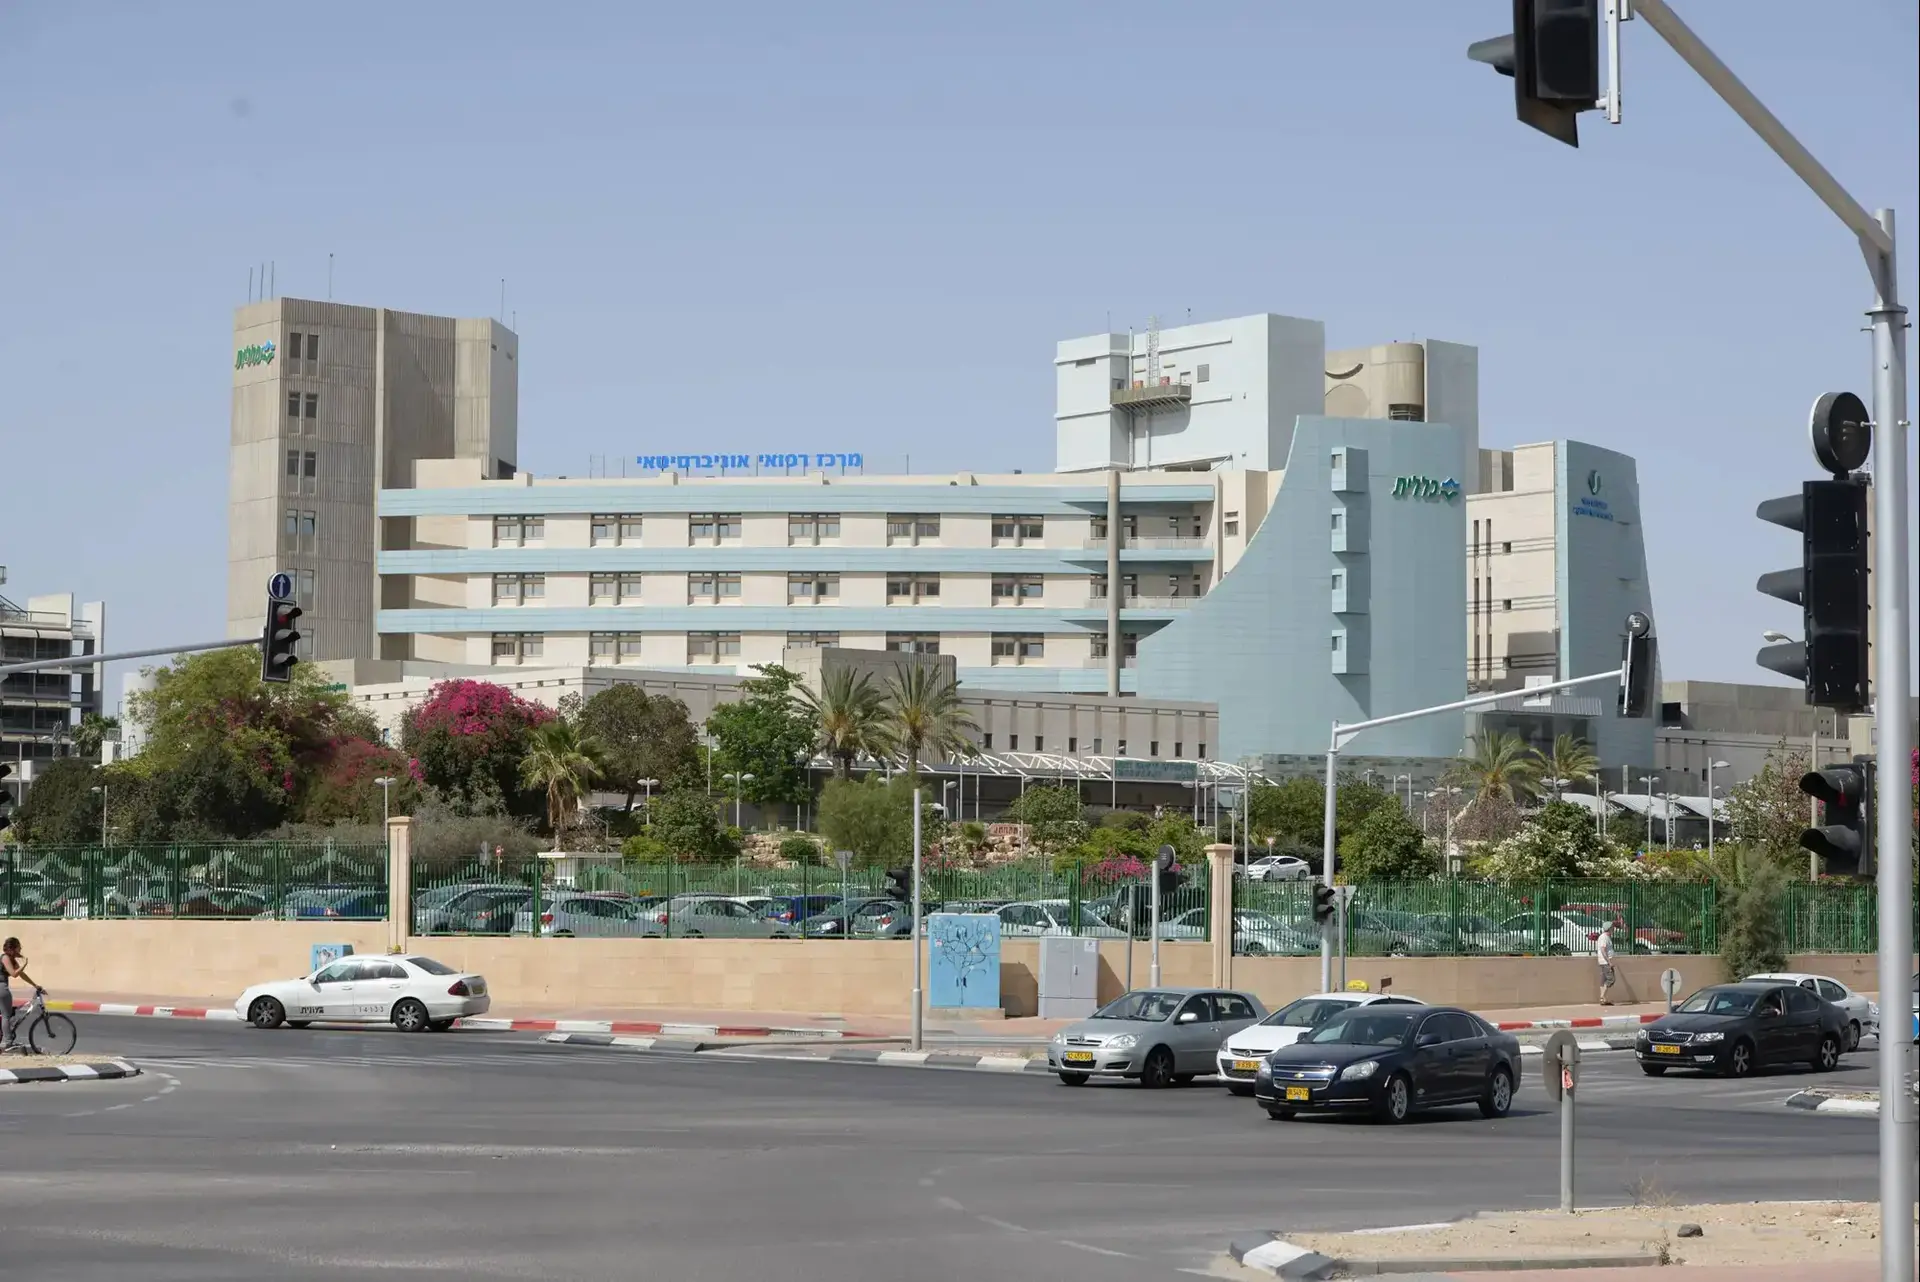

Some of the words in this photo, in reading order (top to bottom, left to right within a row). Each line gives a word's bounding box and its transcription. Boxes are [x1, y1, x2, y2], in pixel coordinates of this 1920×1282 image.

[636, 454, 749, 469] אוניברסיטאי
[758, 453, 809, 468] רפואי
[816, 453, 862, 467] מרכז
[1391, 475, 1438, 497] כללית
